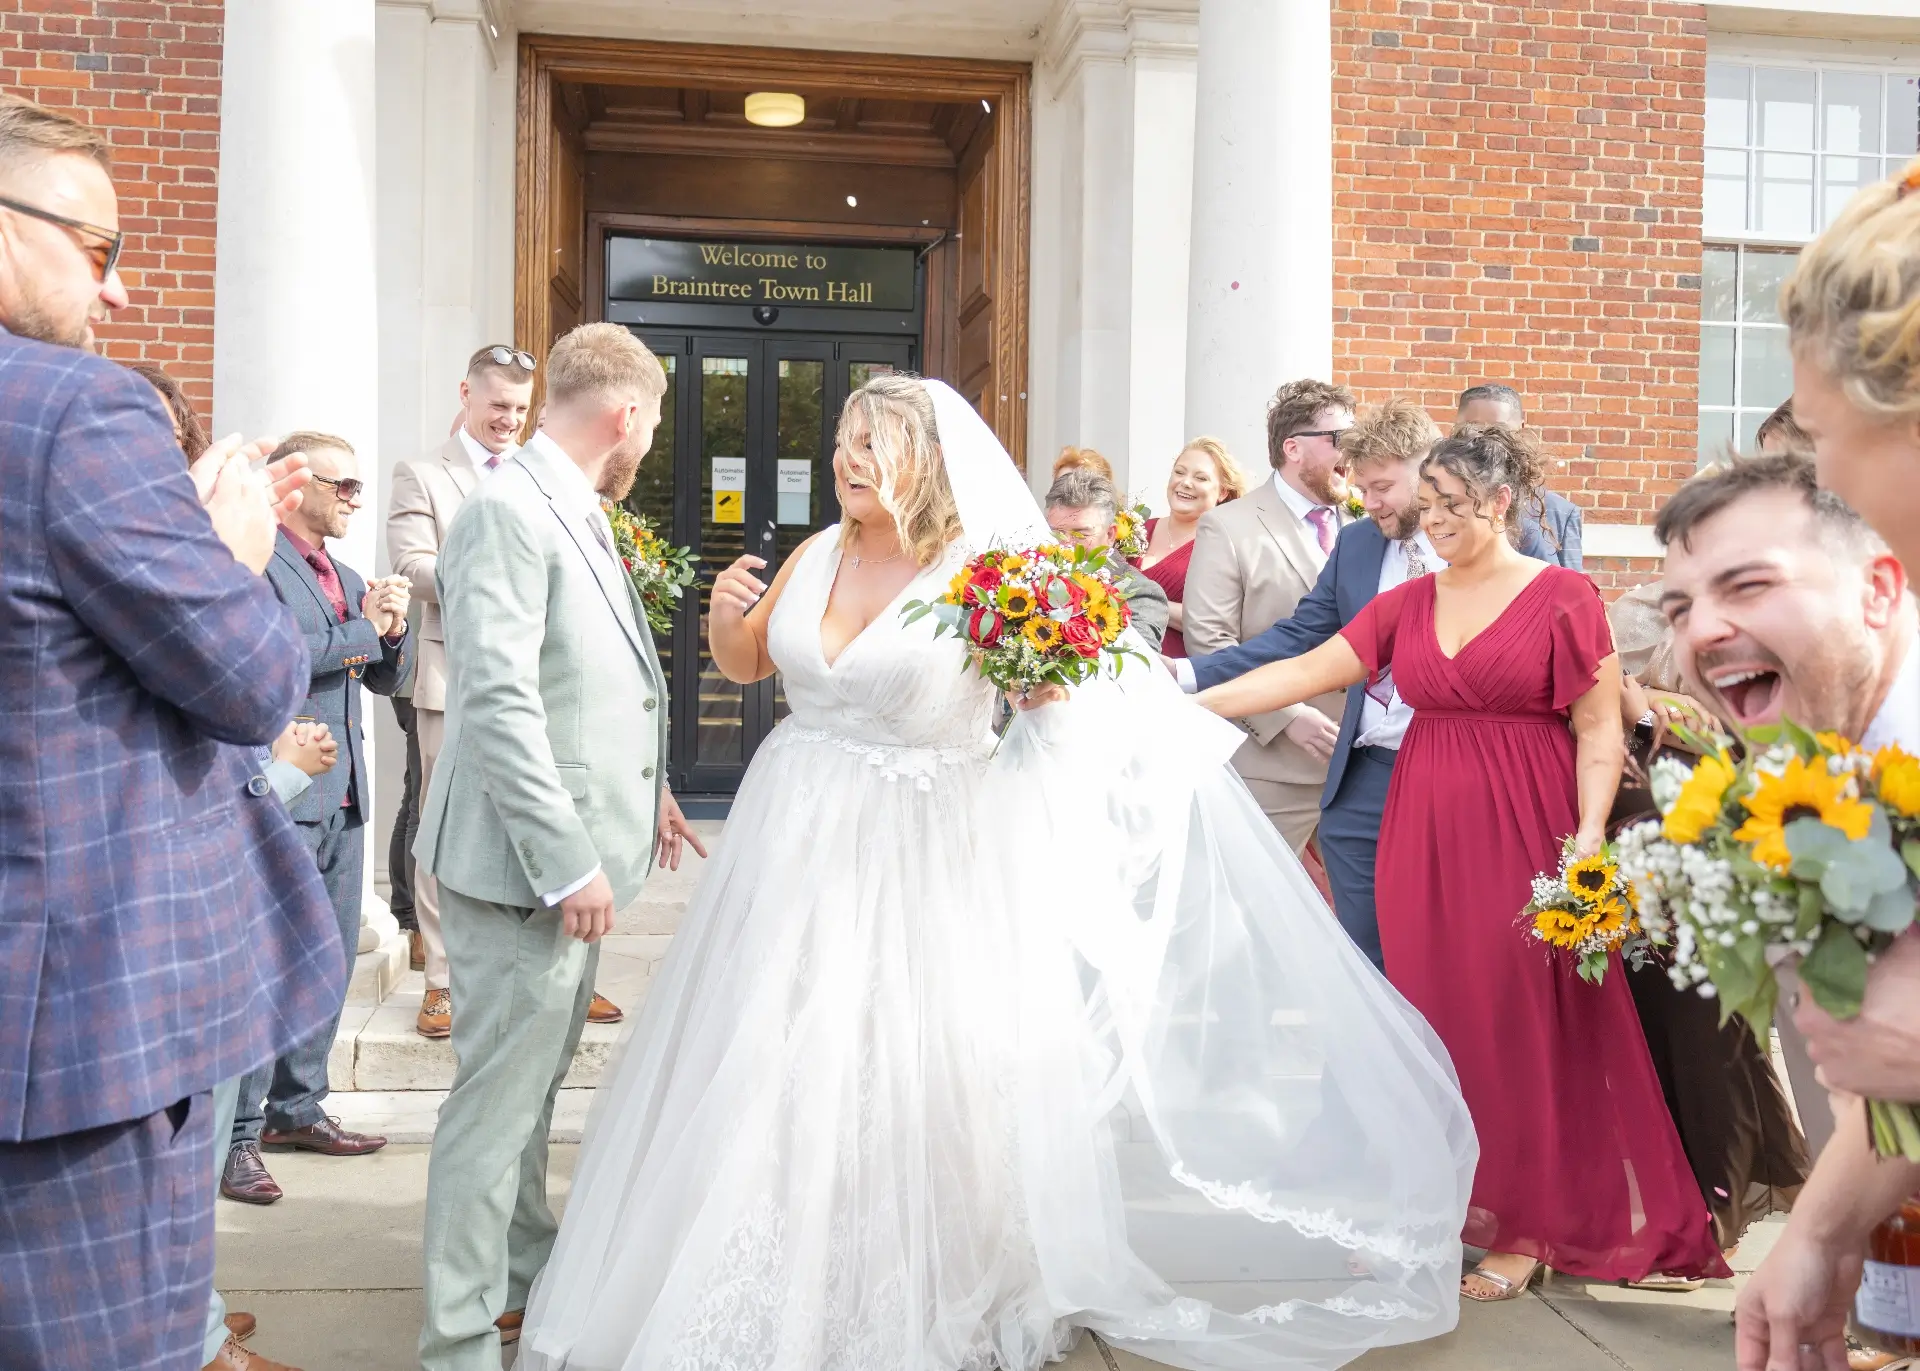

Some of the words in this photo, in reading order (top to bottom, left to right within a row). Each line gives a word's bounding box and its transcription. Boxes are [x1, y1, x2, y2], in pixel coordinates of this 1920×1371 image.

[699, 243, 798, 269] Welcome
[805, 252, 827, 270] to
[651, 274, 752, 299] Braintree
[759, 278, 820, 301] Town
[826, 281, 873, 303] Hall
